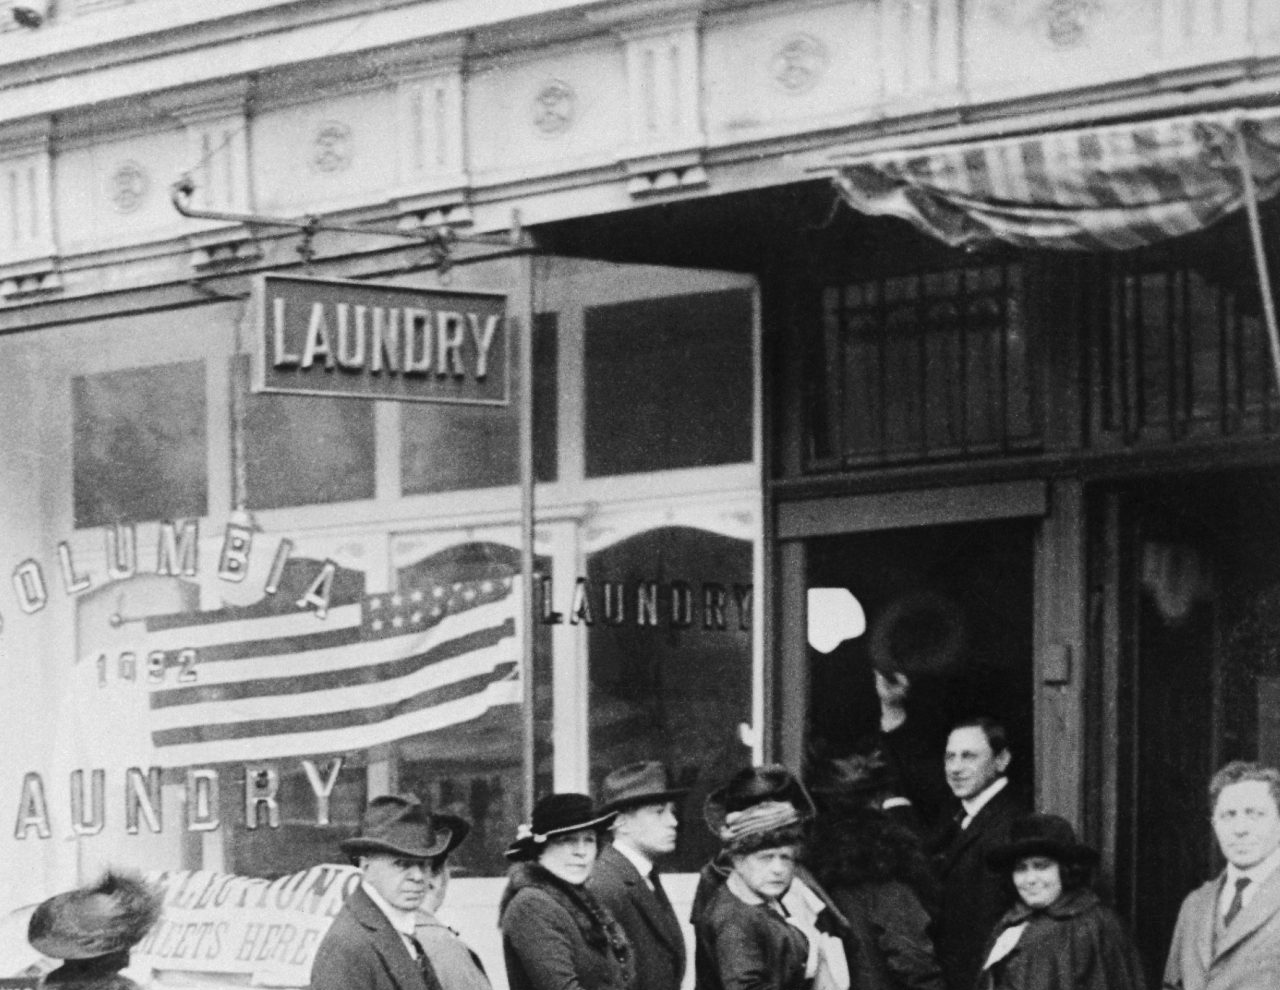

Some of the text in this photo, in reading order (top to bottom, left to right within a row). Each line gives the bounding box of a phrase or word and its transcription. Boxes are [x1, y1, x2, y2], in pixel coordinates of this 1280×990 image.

[272, 297, 503, 380] LAUNDRY
[540, 574, 754, 631] LAUNDRY
[234, 922, 320, 966] HERE
